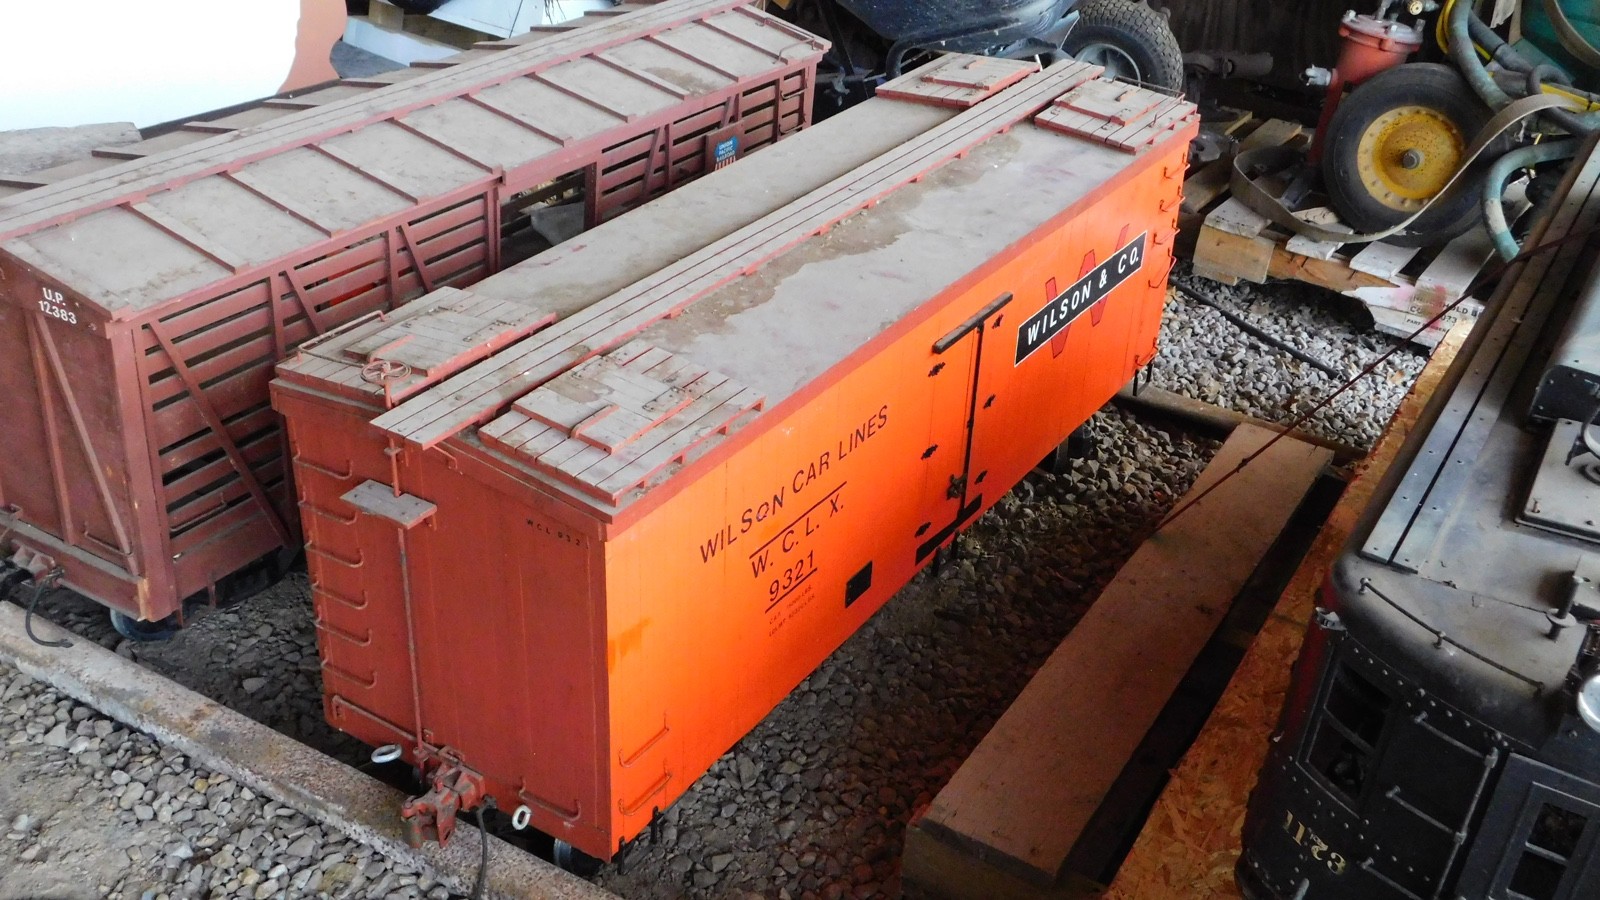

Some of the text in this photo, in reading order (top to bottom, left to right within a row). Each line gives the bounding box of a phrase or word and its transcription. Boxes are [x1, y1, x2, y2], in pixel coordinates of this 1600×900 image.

[38, 300, 77, 324] 12383
[42, 287, 66, 306] U.P.
[1027, 246, 1140, 346] WILSON & CO.
[699, 405, 888, 564] WILSON CAR LINES
[769, 550, 814, 602] 9321
